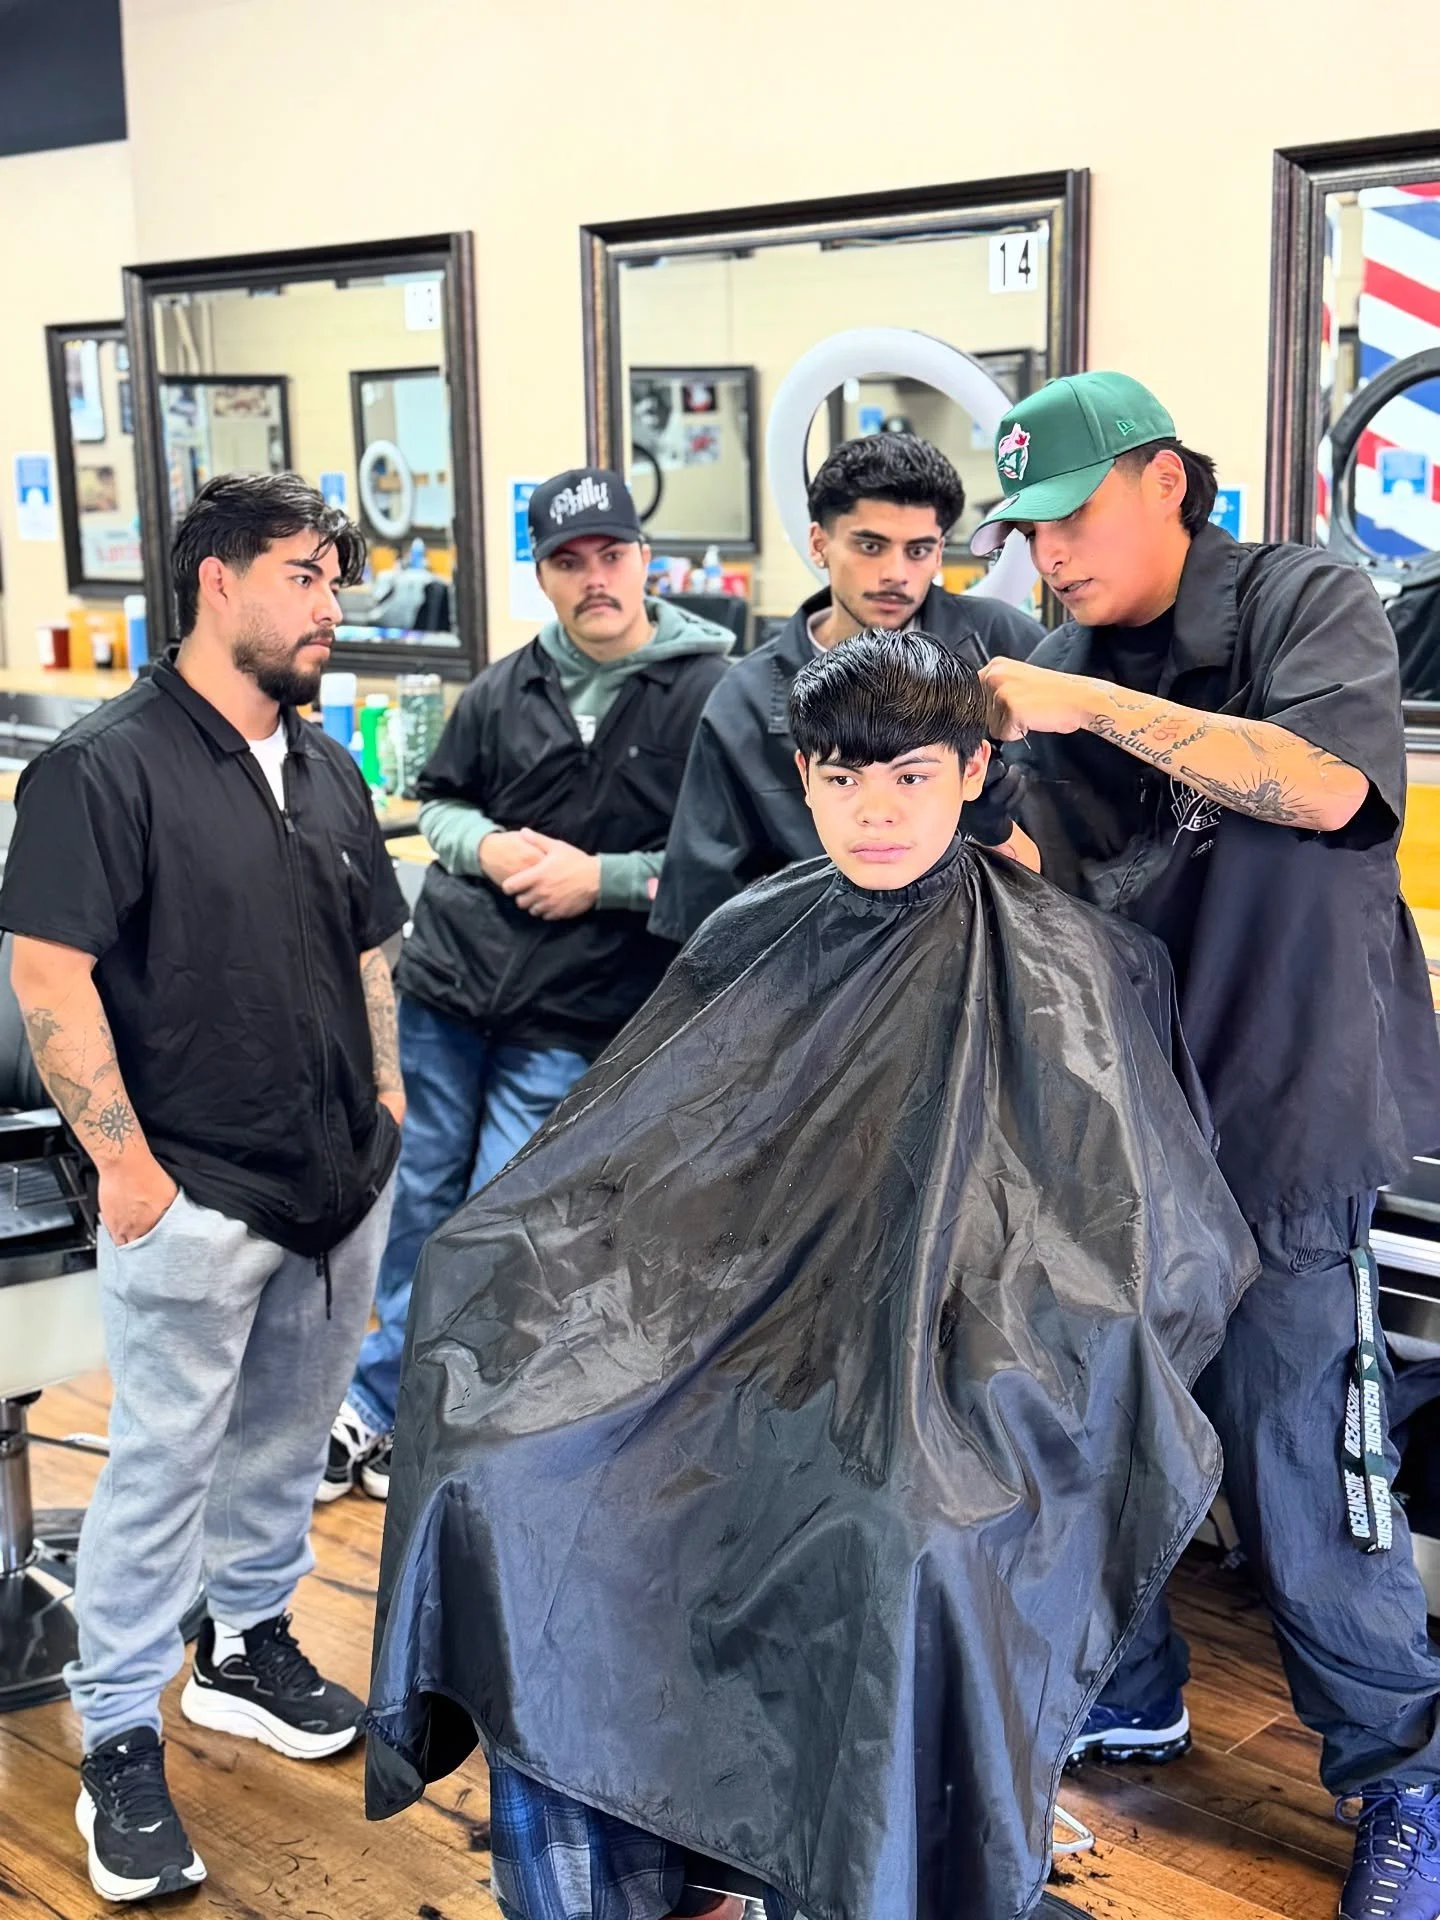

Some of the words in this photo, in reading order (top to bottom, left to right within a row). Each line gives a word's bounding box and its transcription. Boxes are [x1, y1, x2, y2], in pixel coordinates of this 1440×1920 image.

[999, 239, 1031, 287] 14
[549, 476, 609, 525] Philly
[1088, 714, 1173, 764] Gratitude
[1358, 1267, 1374, 1343] OCEANSIDE
[1344, 1380, 1361, 1459] OCEANSIDE
[1363, 1379, 1383, 1456] OCEANSIDE
[1344, 1468, 1371, 1539] OCEANSIDE
[1369, 1474, 1393, 1550] OCEANSIDE
